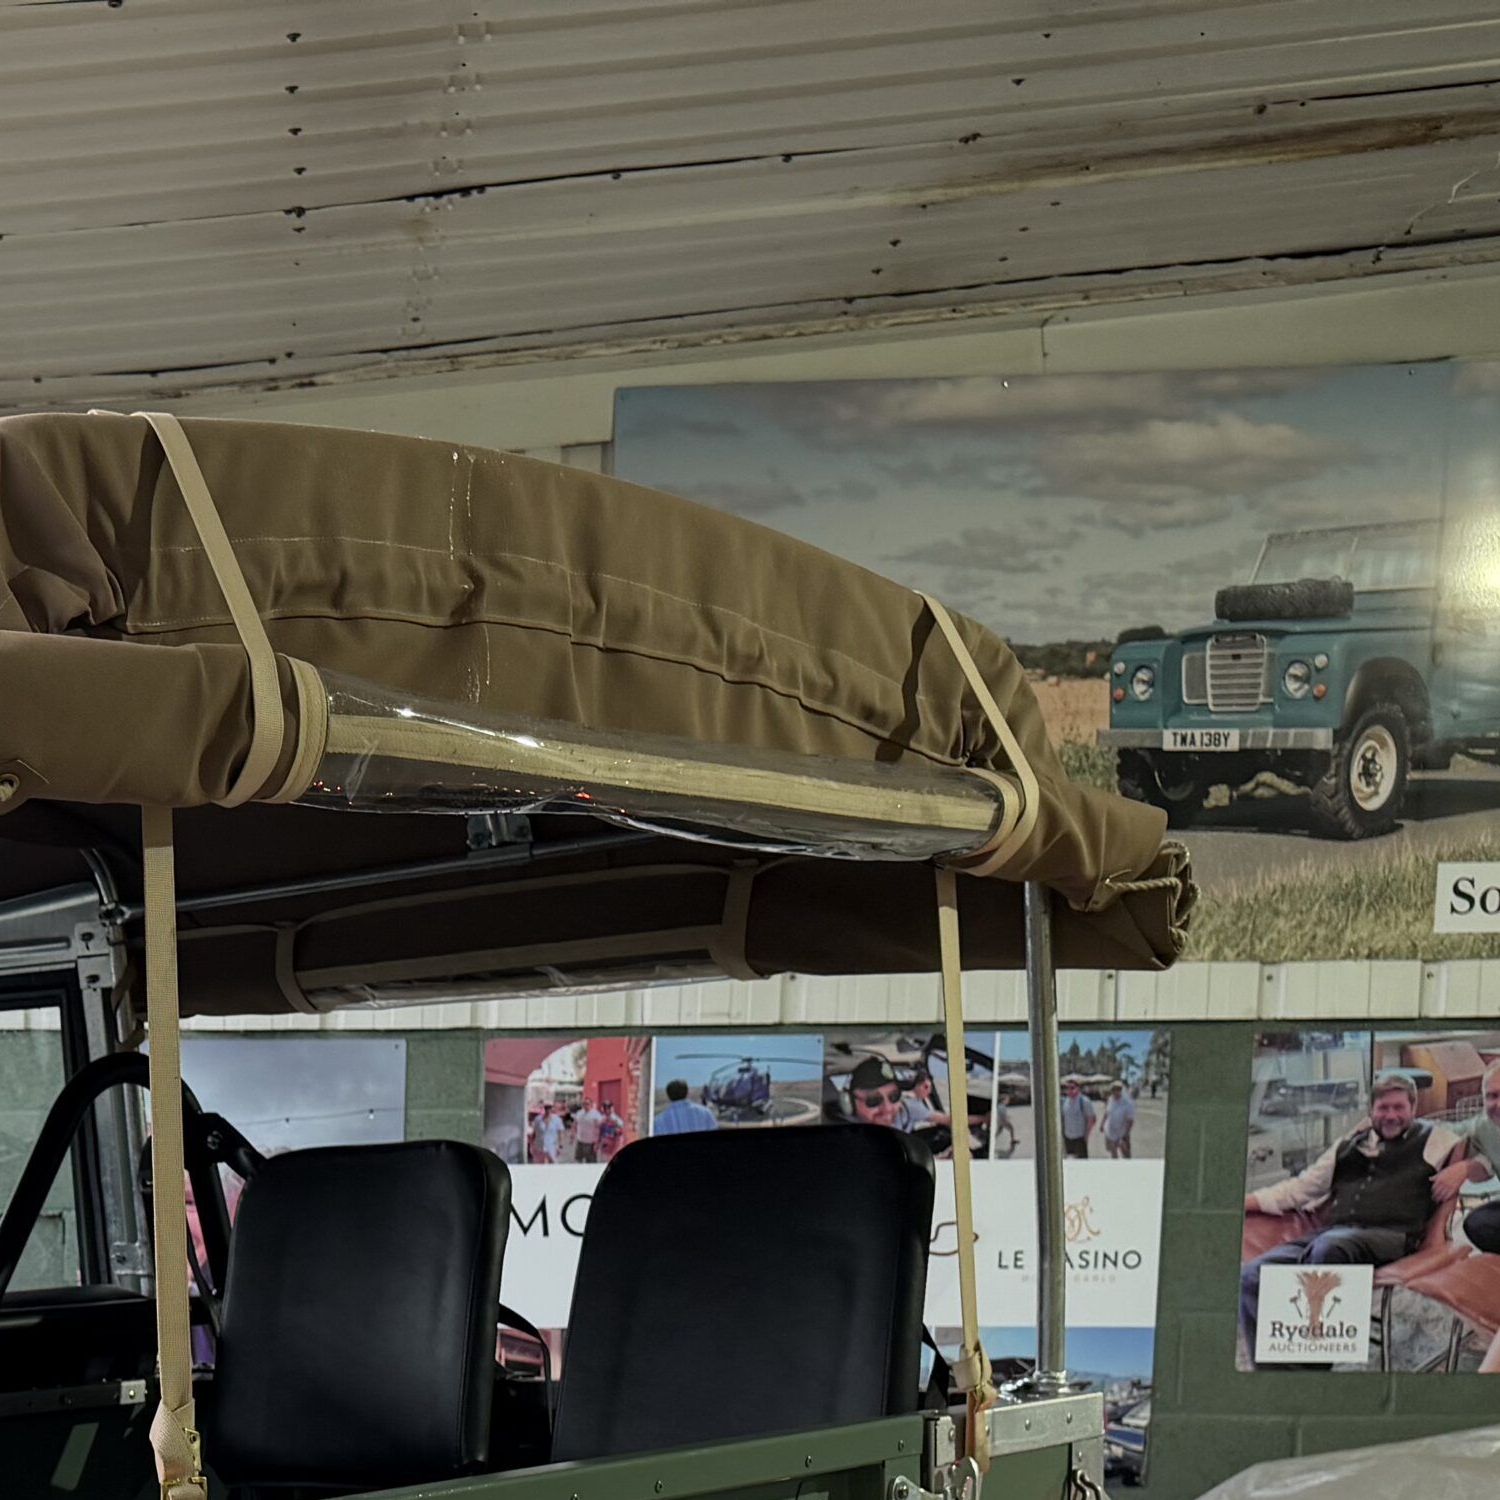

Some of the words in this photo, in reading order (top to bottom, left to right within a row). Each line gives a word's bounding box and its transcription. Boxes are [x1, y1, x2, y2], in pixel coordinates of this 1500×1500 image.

[1172, 732, 1196, 747] TWA
[1200, 732, 1231, 747] 138Y
[998, 1250, 1024, 1269] LE
[1064, 1250, 1142, 1269] SINO
[1269, 1321, 1358, 1341] Ryedale
[1268, 1342, 1357, 1353] AUCTIONEERS
